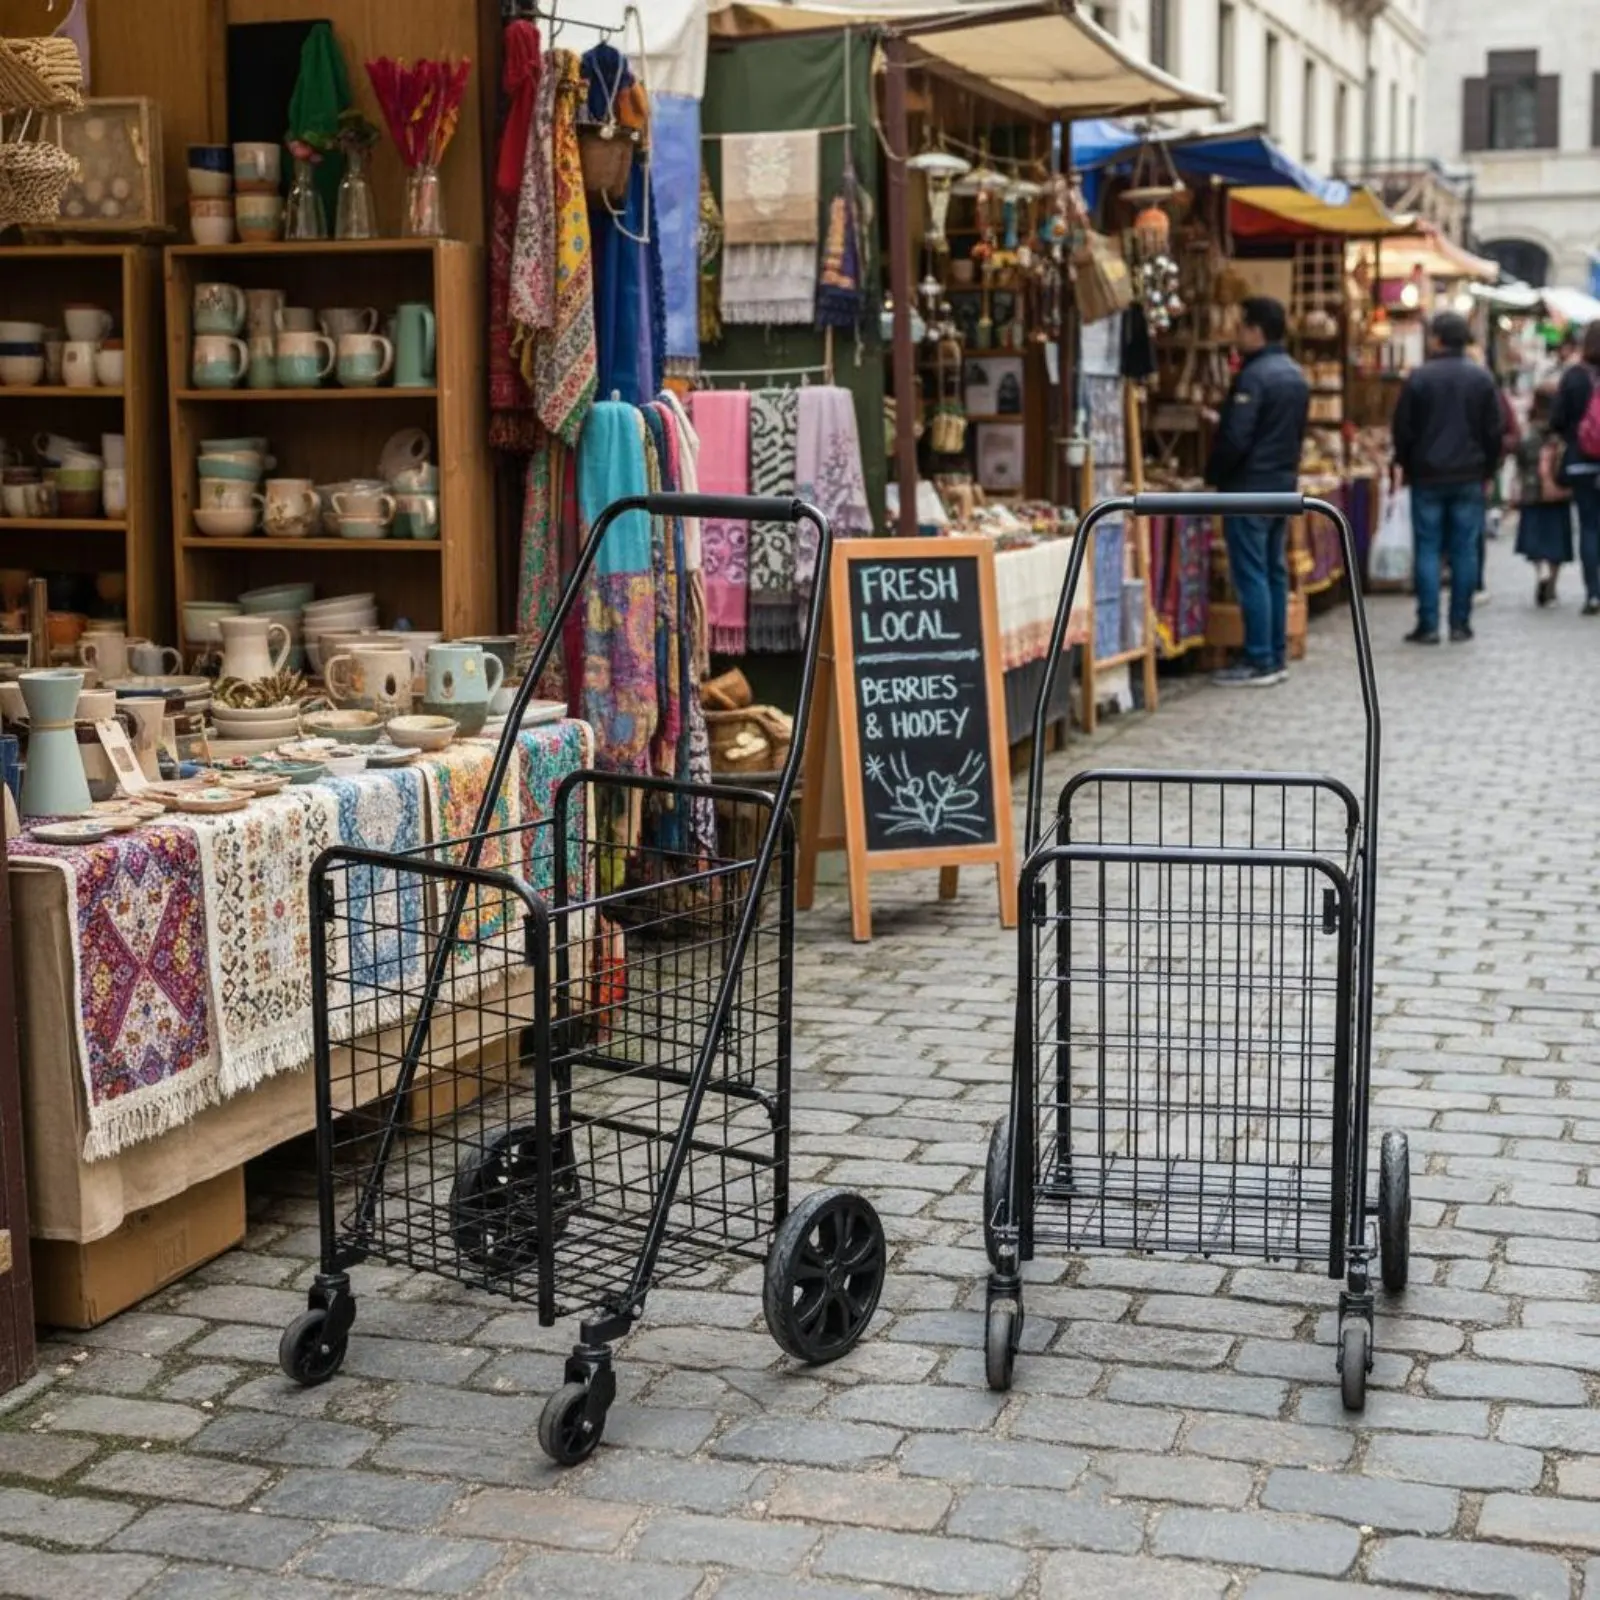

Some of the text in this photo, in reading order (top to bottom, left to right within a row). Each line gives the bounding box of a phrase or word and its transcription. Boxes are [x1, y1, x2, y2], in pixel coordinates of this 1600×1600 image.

[860, 566, 959, 605] FRESH
[861, 609, 962, 643] LOCAL
[866, 706, 970, 739] & HODEY
